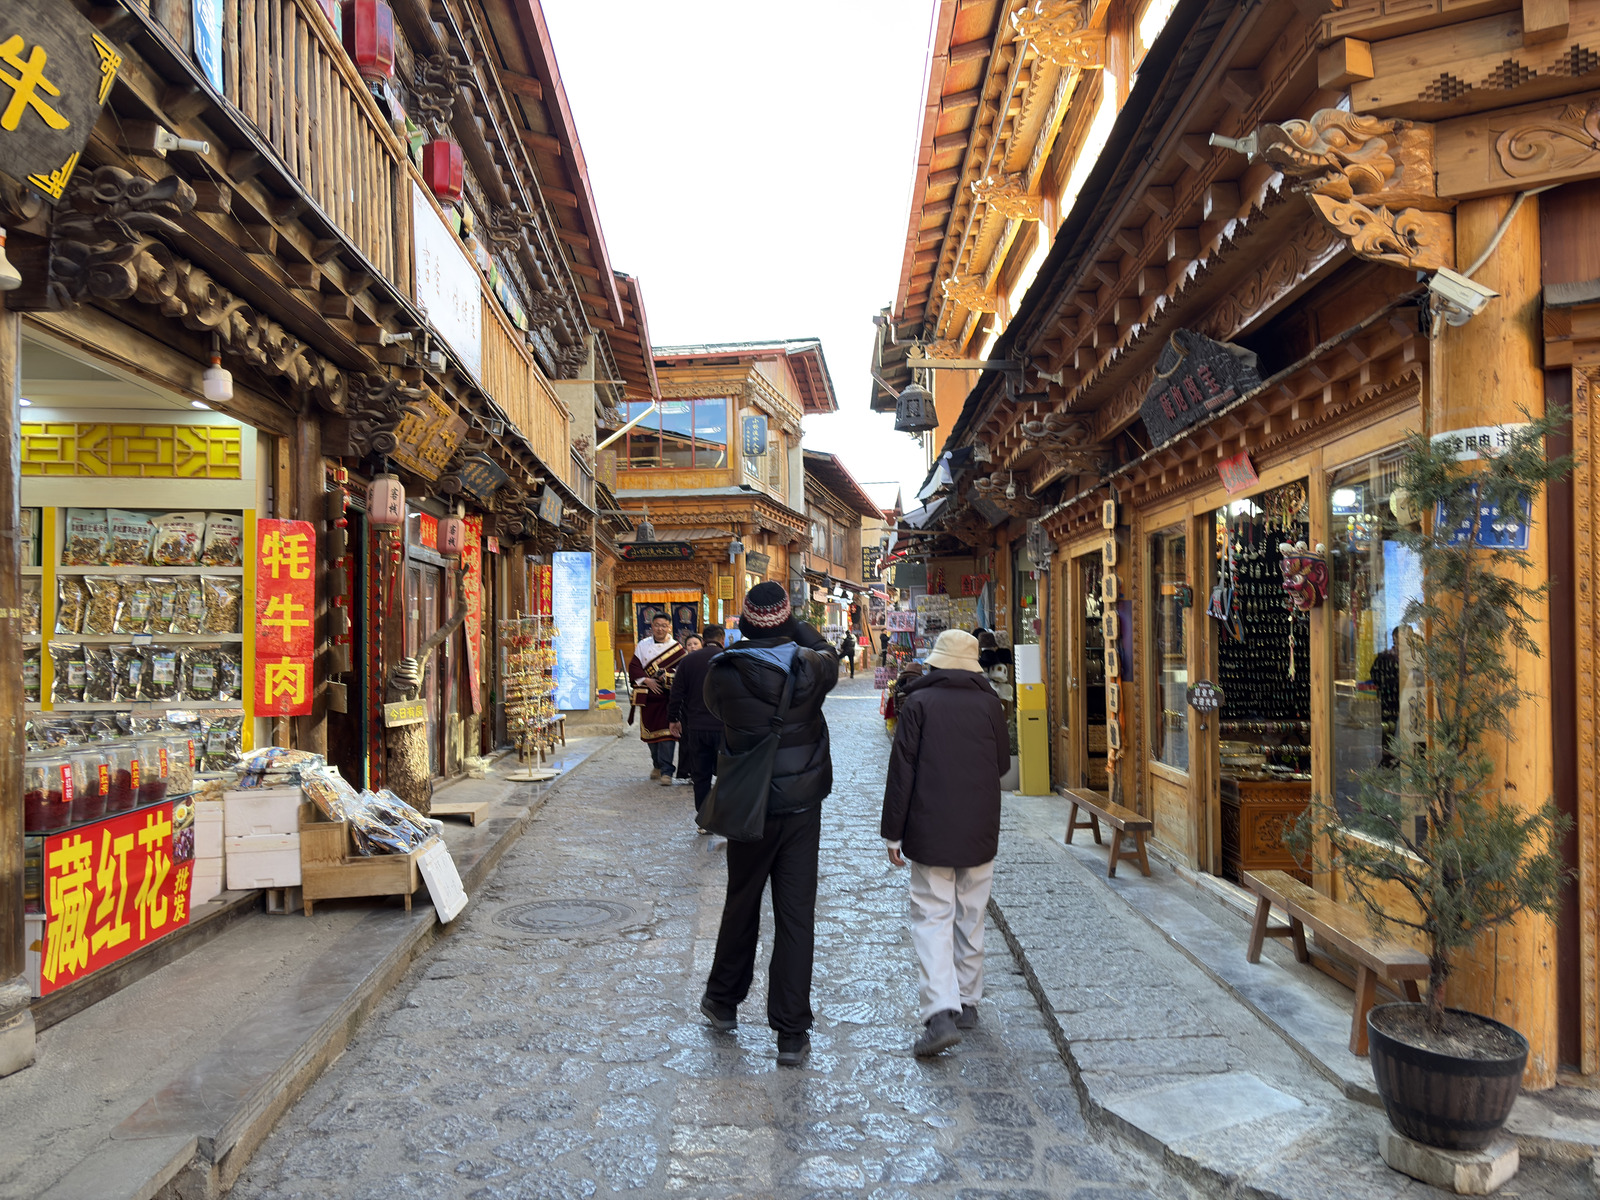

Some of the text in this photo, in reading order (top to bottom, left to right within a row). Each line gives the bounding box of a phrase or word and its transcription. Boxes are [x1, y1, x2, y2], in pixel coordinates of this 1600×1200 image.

[0, 34, 70, 131] 牛
[261, 530, 311, 706] 牦牛肉
[390, 704, 423, 721] 今日有房
[42, 809, 173, 985] 藏红花
[173, 867, 190, 923] 批发
